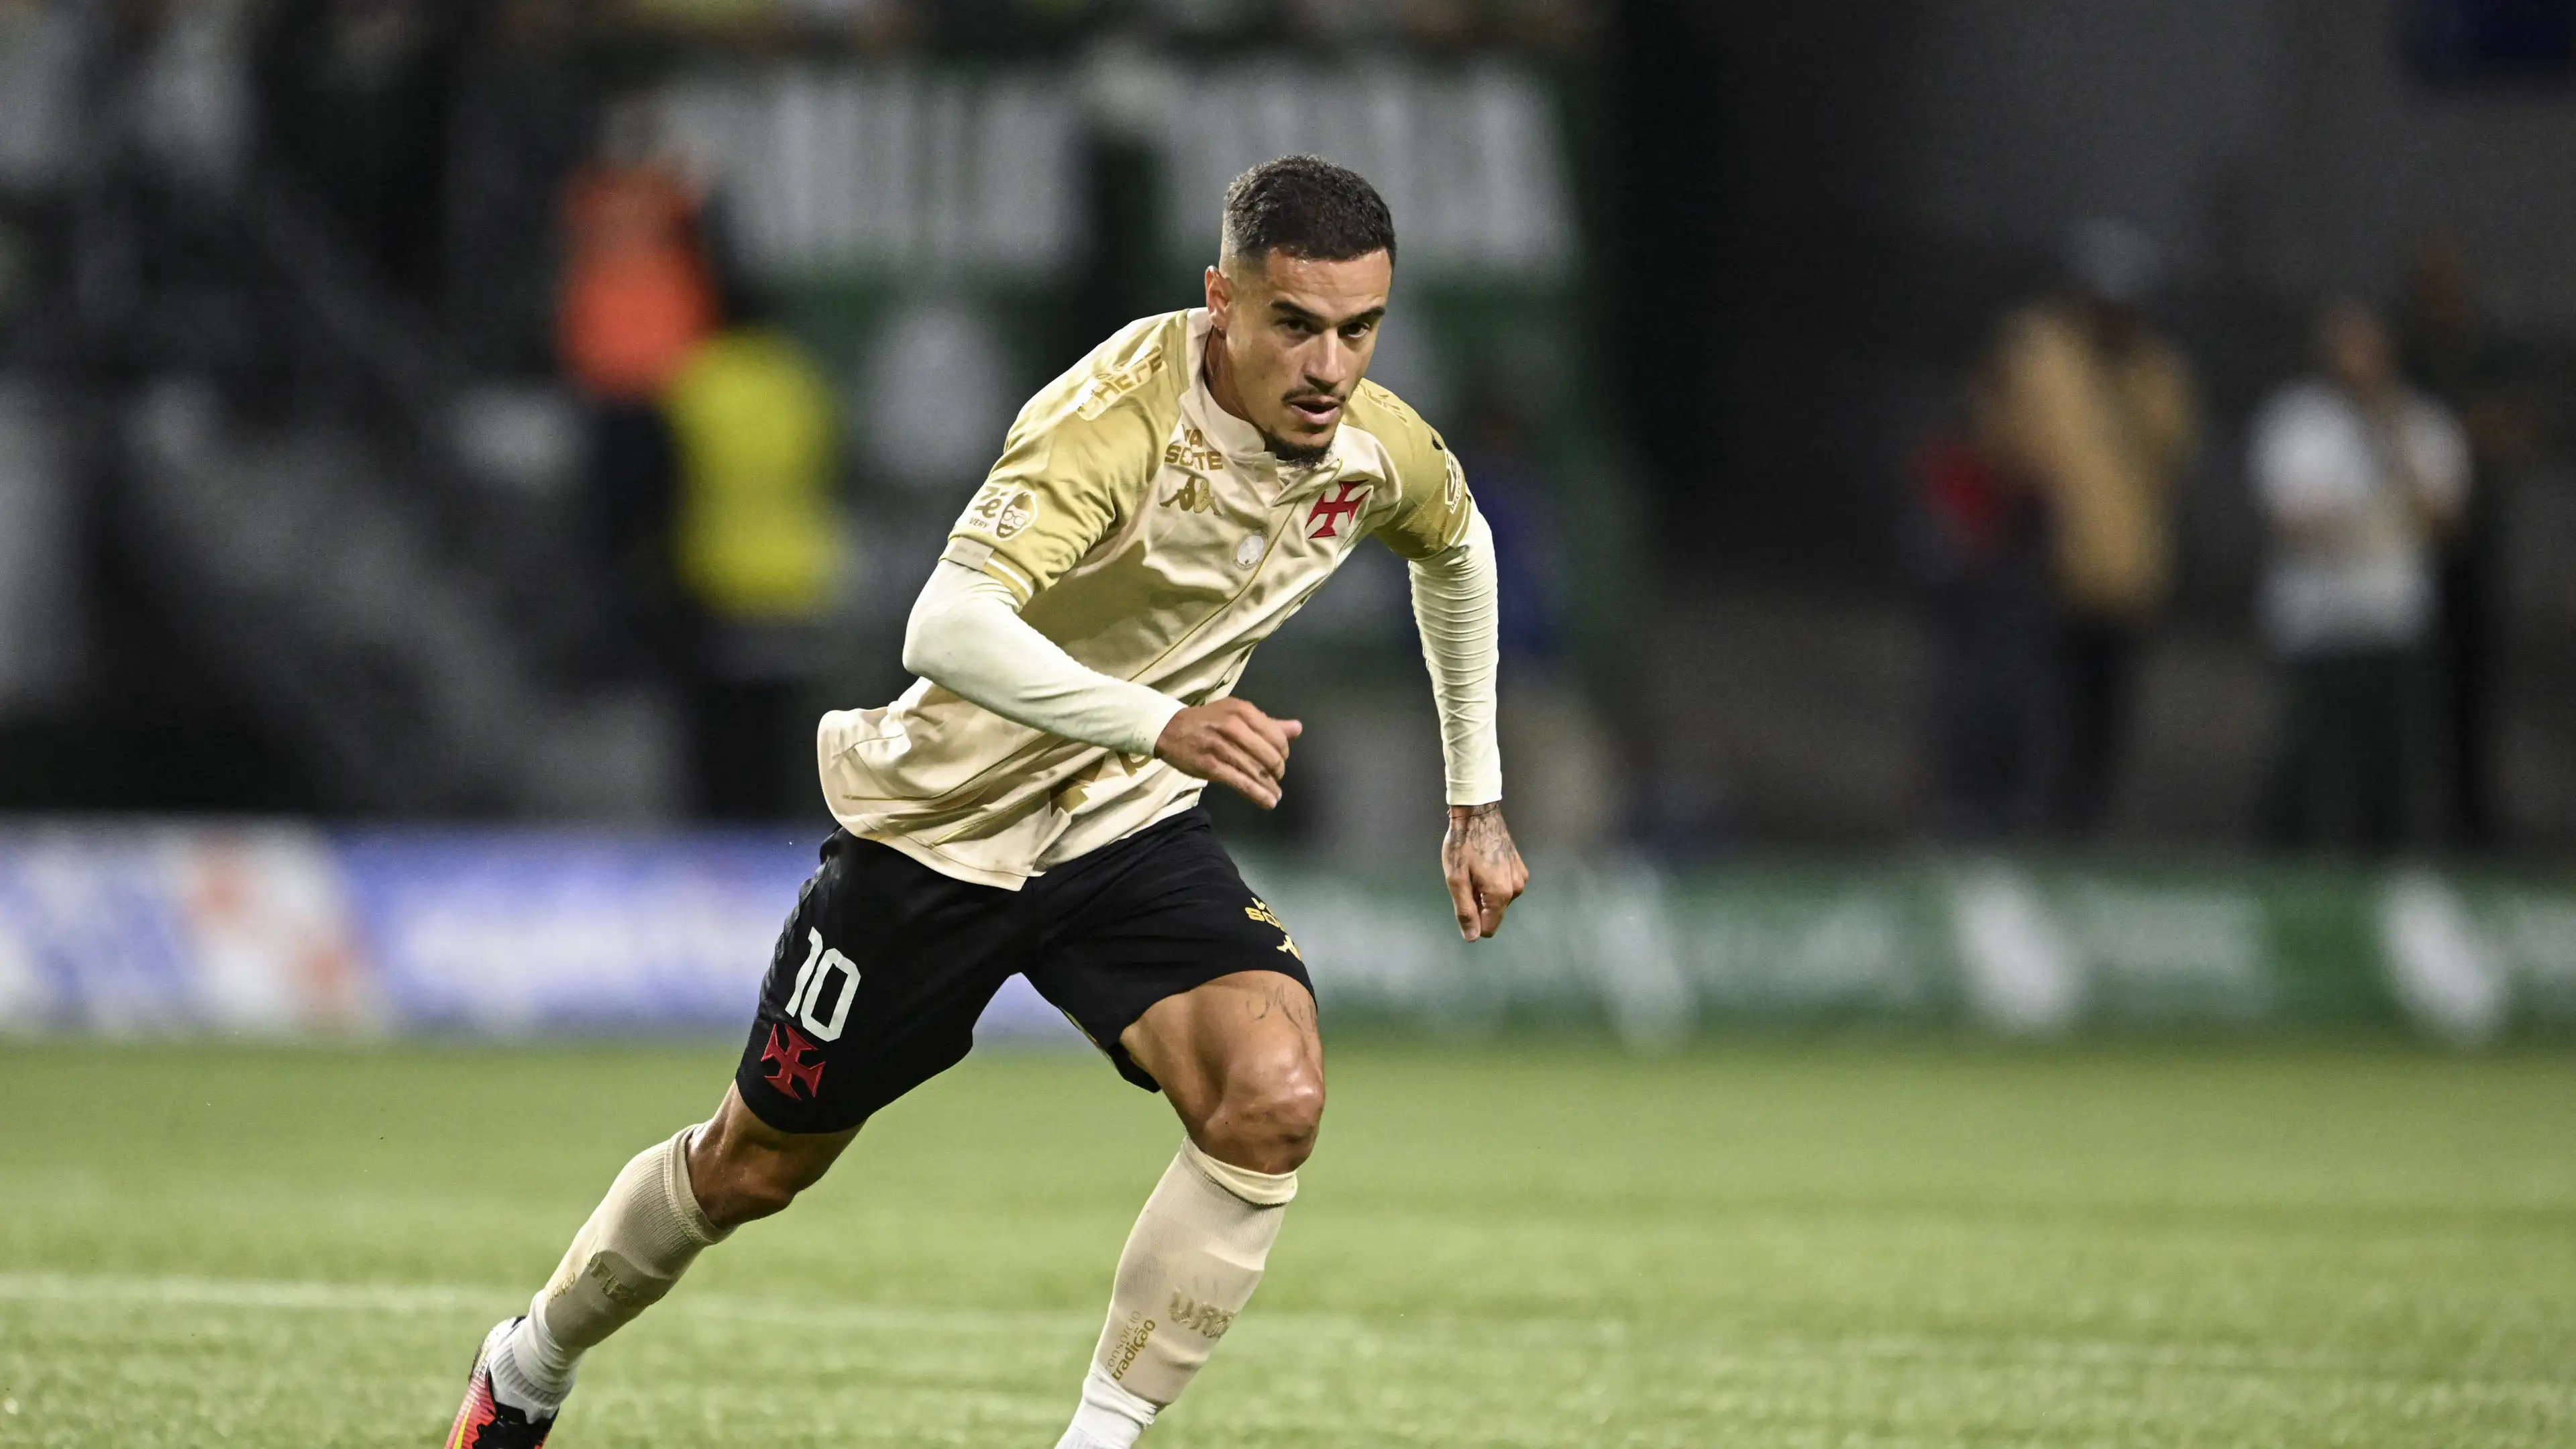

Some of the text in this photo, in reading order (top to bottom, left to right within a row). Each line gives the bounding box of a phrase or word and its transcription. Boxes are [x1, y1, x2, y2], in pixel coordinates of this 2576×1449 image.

[1165, 443, 1223, 470] SOTE
[785, 926, 861, 1042] 10
[1112, 1320, 1155, 1381] tradição
